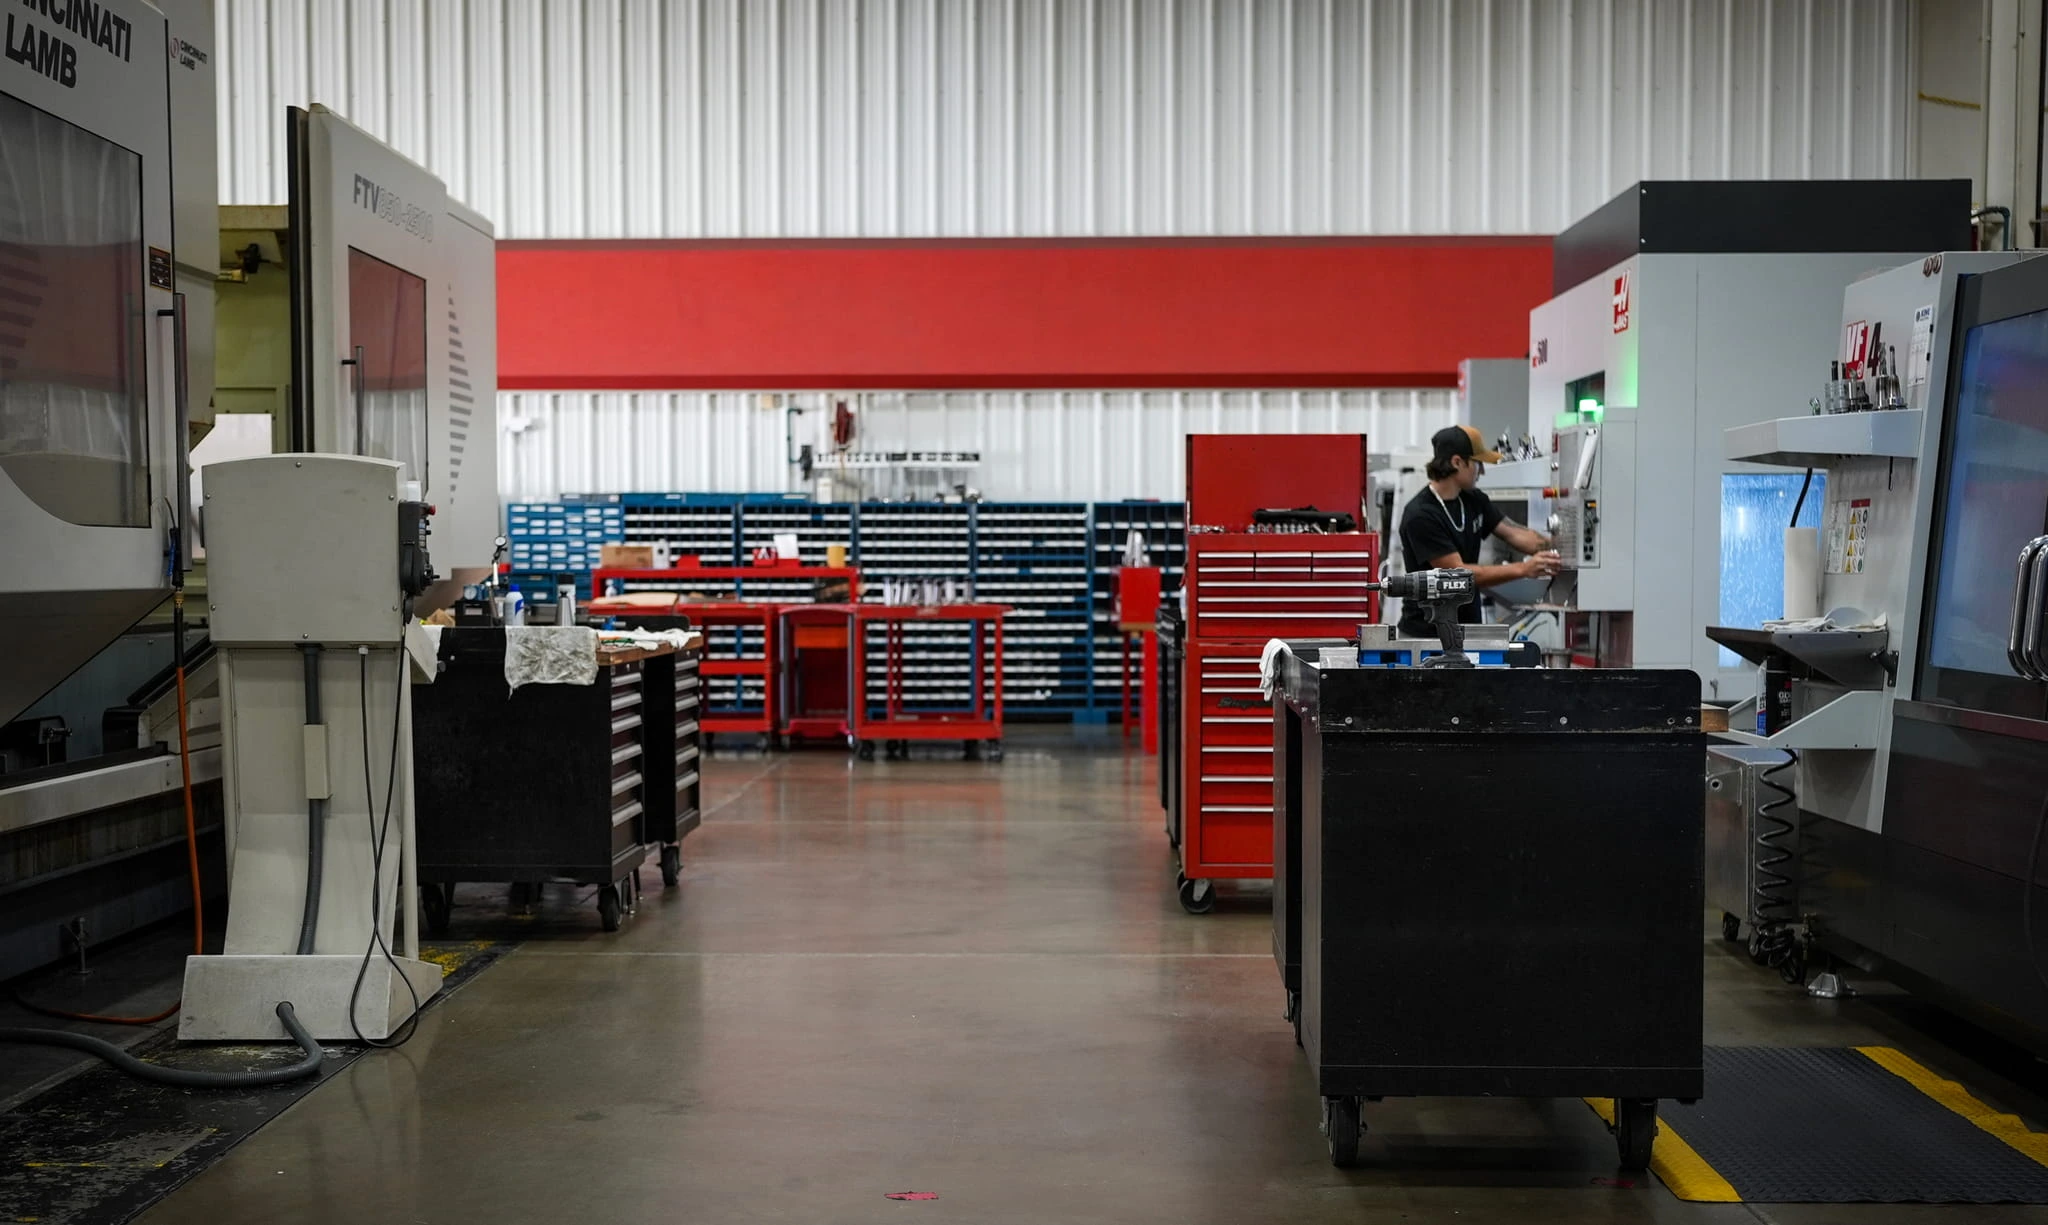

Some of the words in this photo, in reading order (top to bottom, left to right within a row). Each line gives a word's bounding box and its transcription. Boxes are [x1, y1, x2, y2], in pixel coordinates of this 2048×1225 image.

[5, 13, 77, 88] LAMB
[22, 0, 131, 63] CINNATI
[353, 173, 380, 214] FTV
[1867, 321, 1882, 377] 4
[1443, 581, 1466, 589] FLEX
